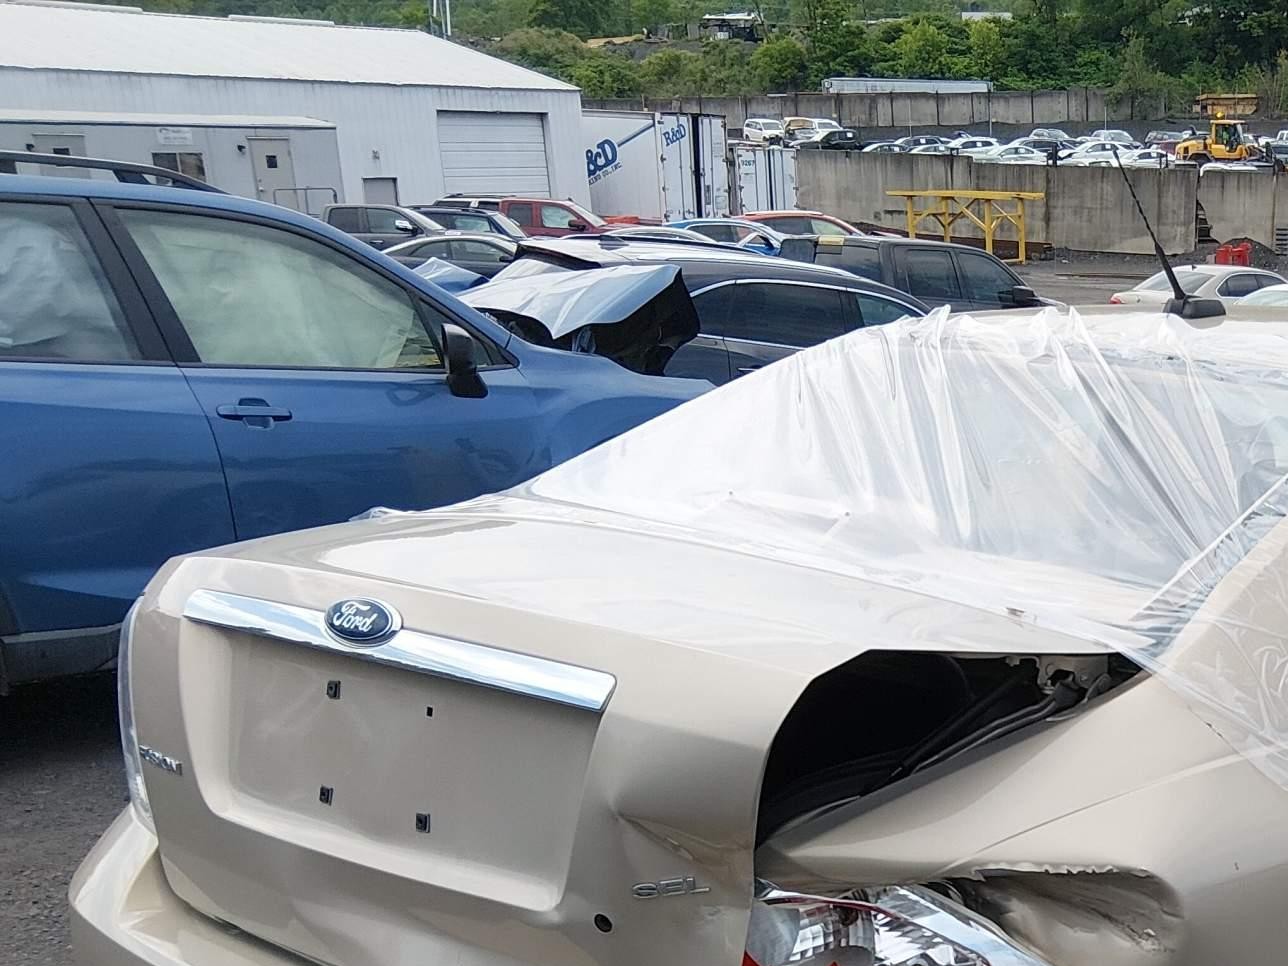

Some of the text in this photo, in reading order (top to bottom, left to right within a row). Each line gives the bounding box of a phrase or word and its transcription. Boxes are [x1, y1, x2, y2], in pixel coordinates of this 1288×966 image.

[662, 123, 687, 147] R&D
[333, 601, 379, 633] Ford
[632, 876, 712, 899] SEL
